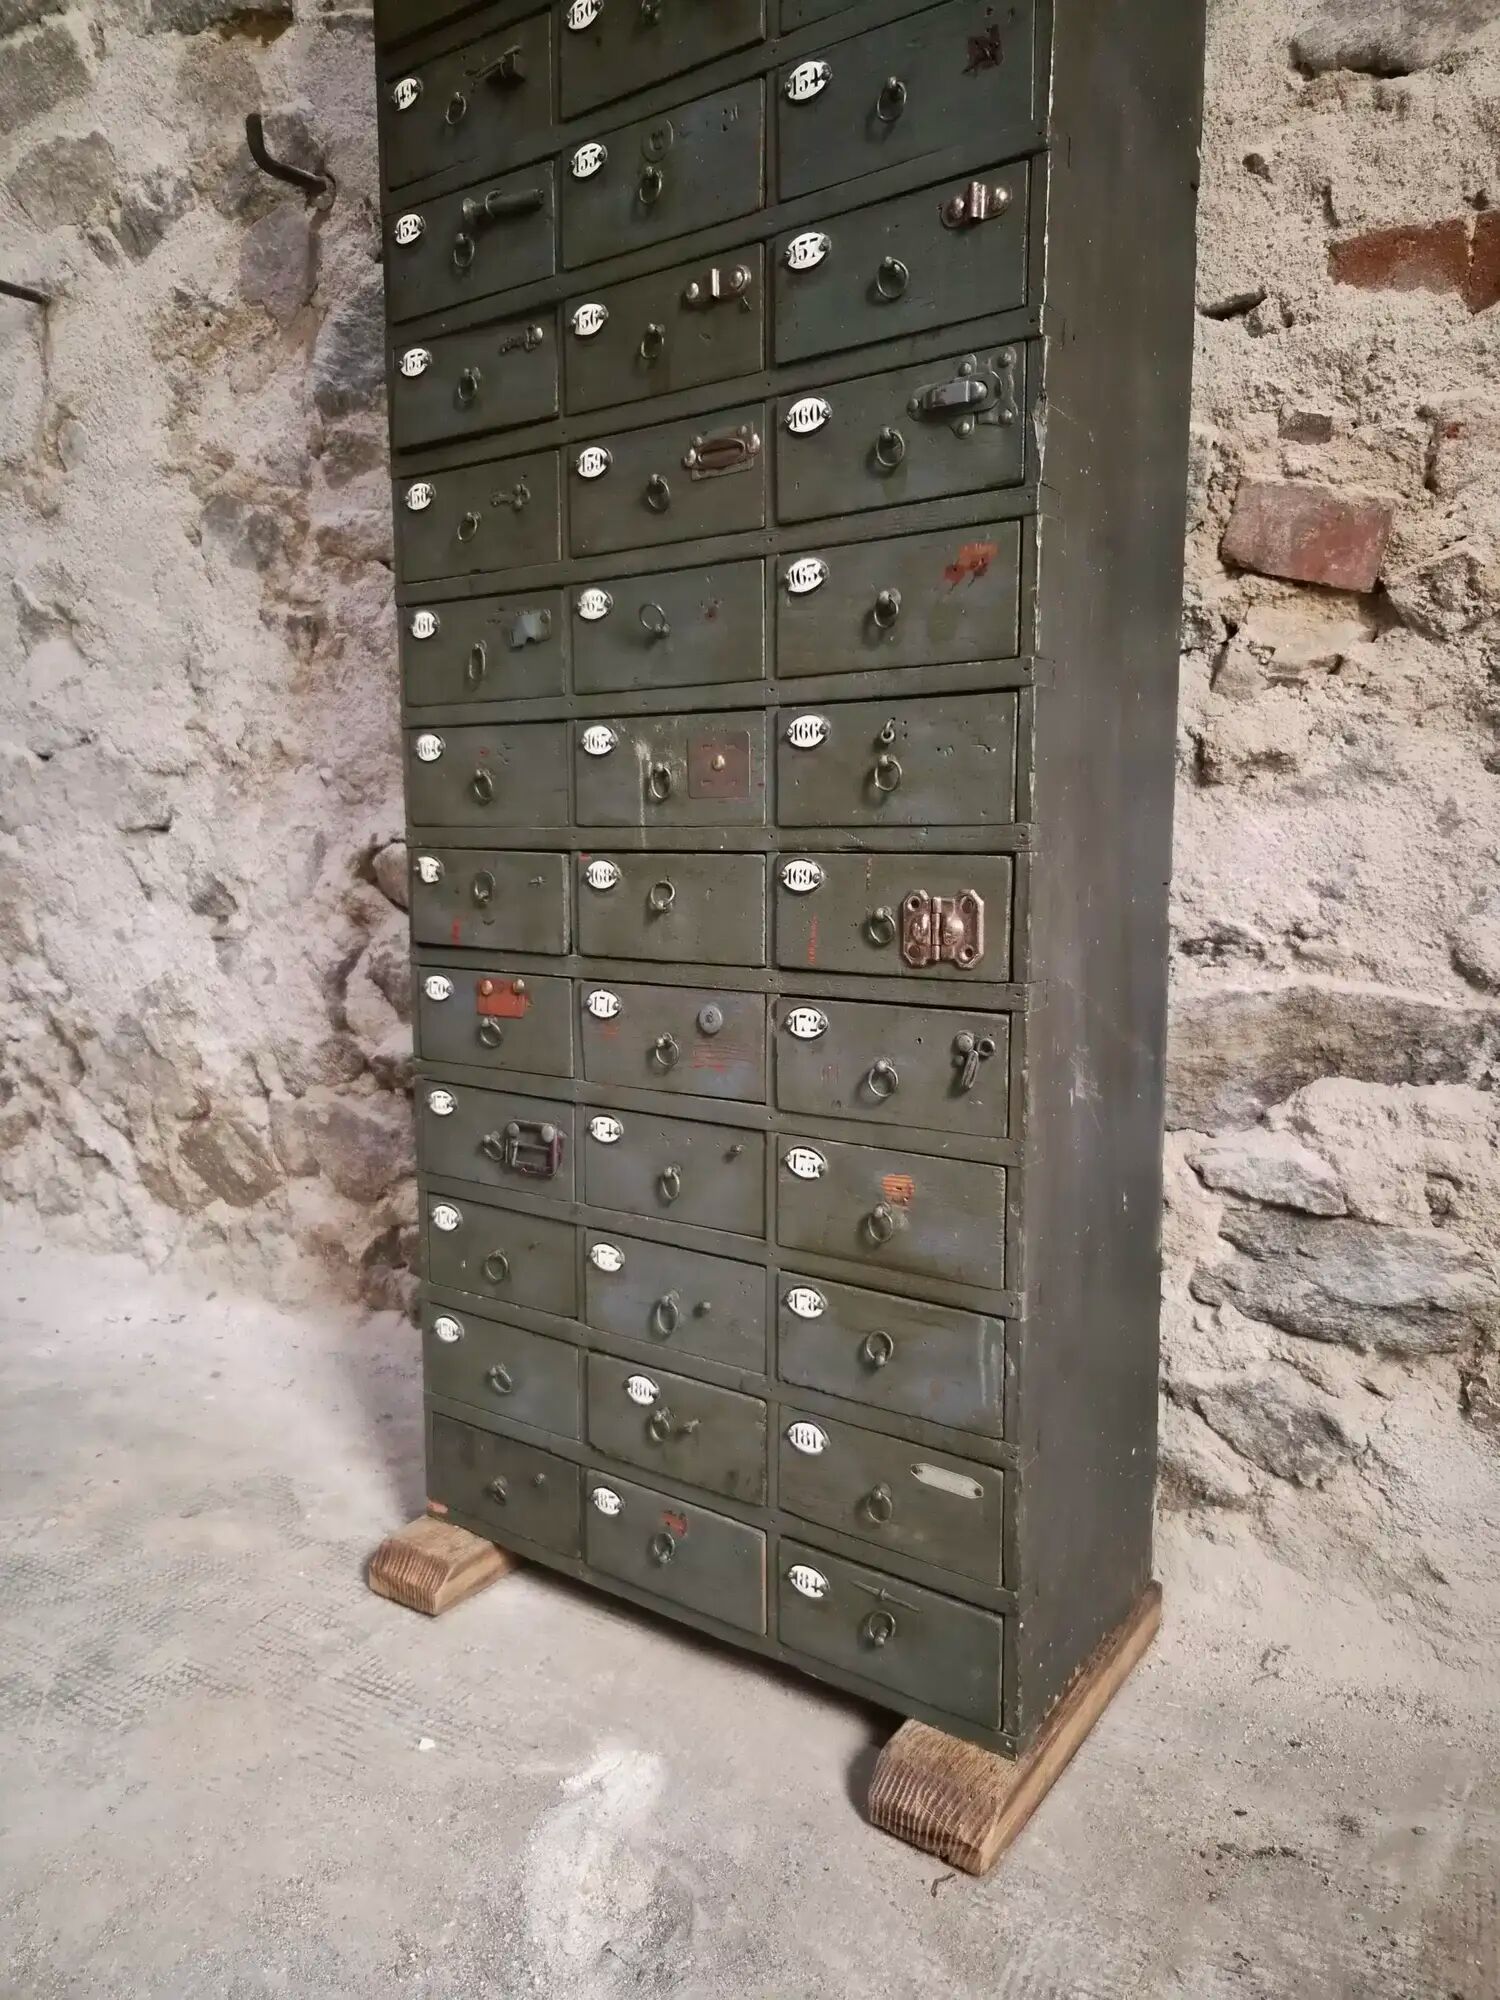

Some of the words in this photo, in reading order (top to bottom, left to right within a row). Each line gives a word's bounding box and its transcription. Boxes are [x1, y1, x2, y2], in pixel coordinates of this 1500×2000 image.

[572, 0, 594, 26] 150
[792, 67, 819, 96] 154
[398, 218, 418, 240] 152
[792, 237, 818, 264] 157
[792, 404, 820, 428] 160
[582, 454, 603, 472] 159
[414, 617, 431, 633] 61
[793, 723, 818, 740] 166
[591, 869, 610, 883] 168
[788, 868, 812, 884] 169
[594, 996, 609, 1012] 171
[794, 1015, 817, 1031] 172
[595, 1121, 613, 1137] 174
[794, 1293, 816, 1310] 178
[795, 1428, 815, 1448] 181
[793, 1571, 817, 1592] 184
